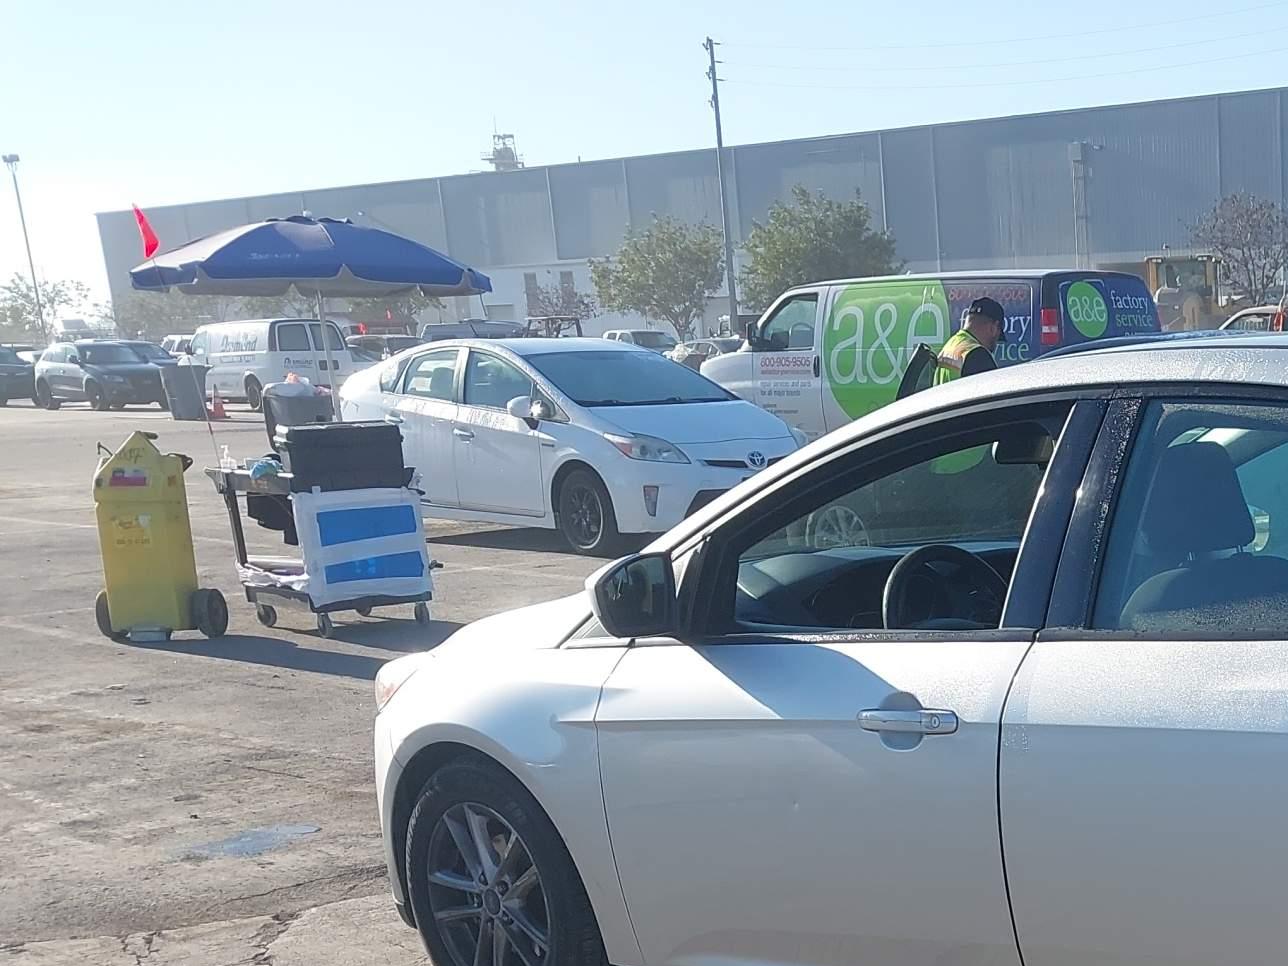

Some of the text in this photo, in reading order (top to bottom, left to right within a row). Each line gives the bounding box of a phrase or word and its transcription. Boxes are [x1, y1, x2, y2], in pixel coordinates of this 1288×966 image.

[1068, 295, 1106, 322] a&e
[1110, 290, 1149, 315] factory
[1115, 312, 1153, 328] service
[830, 302, 945, 385] a&e
